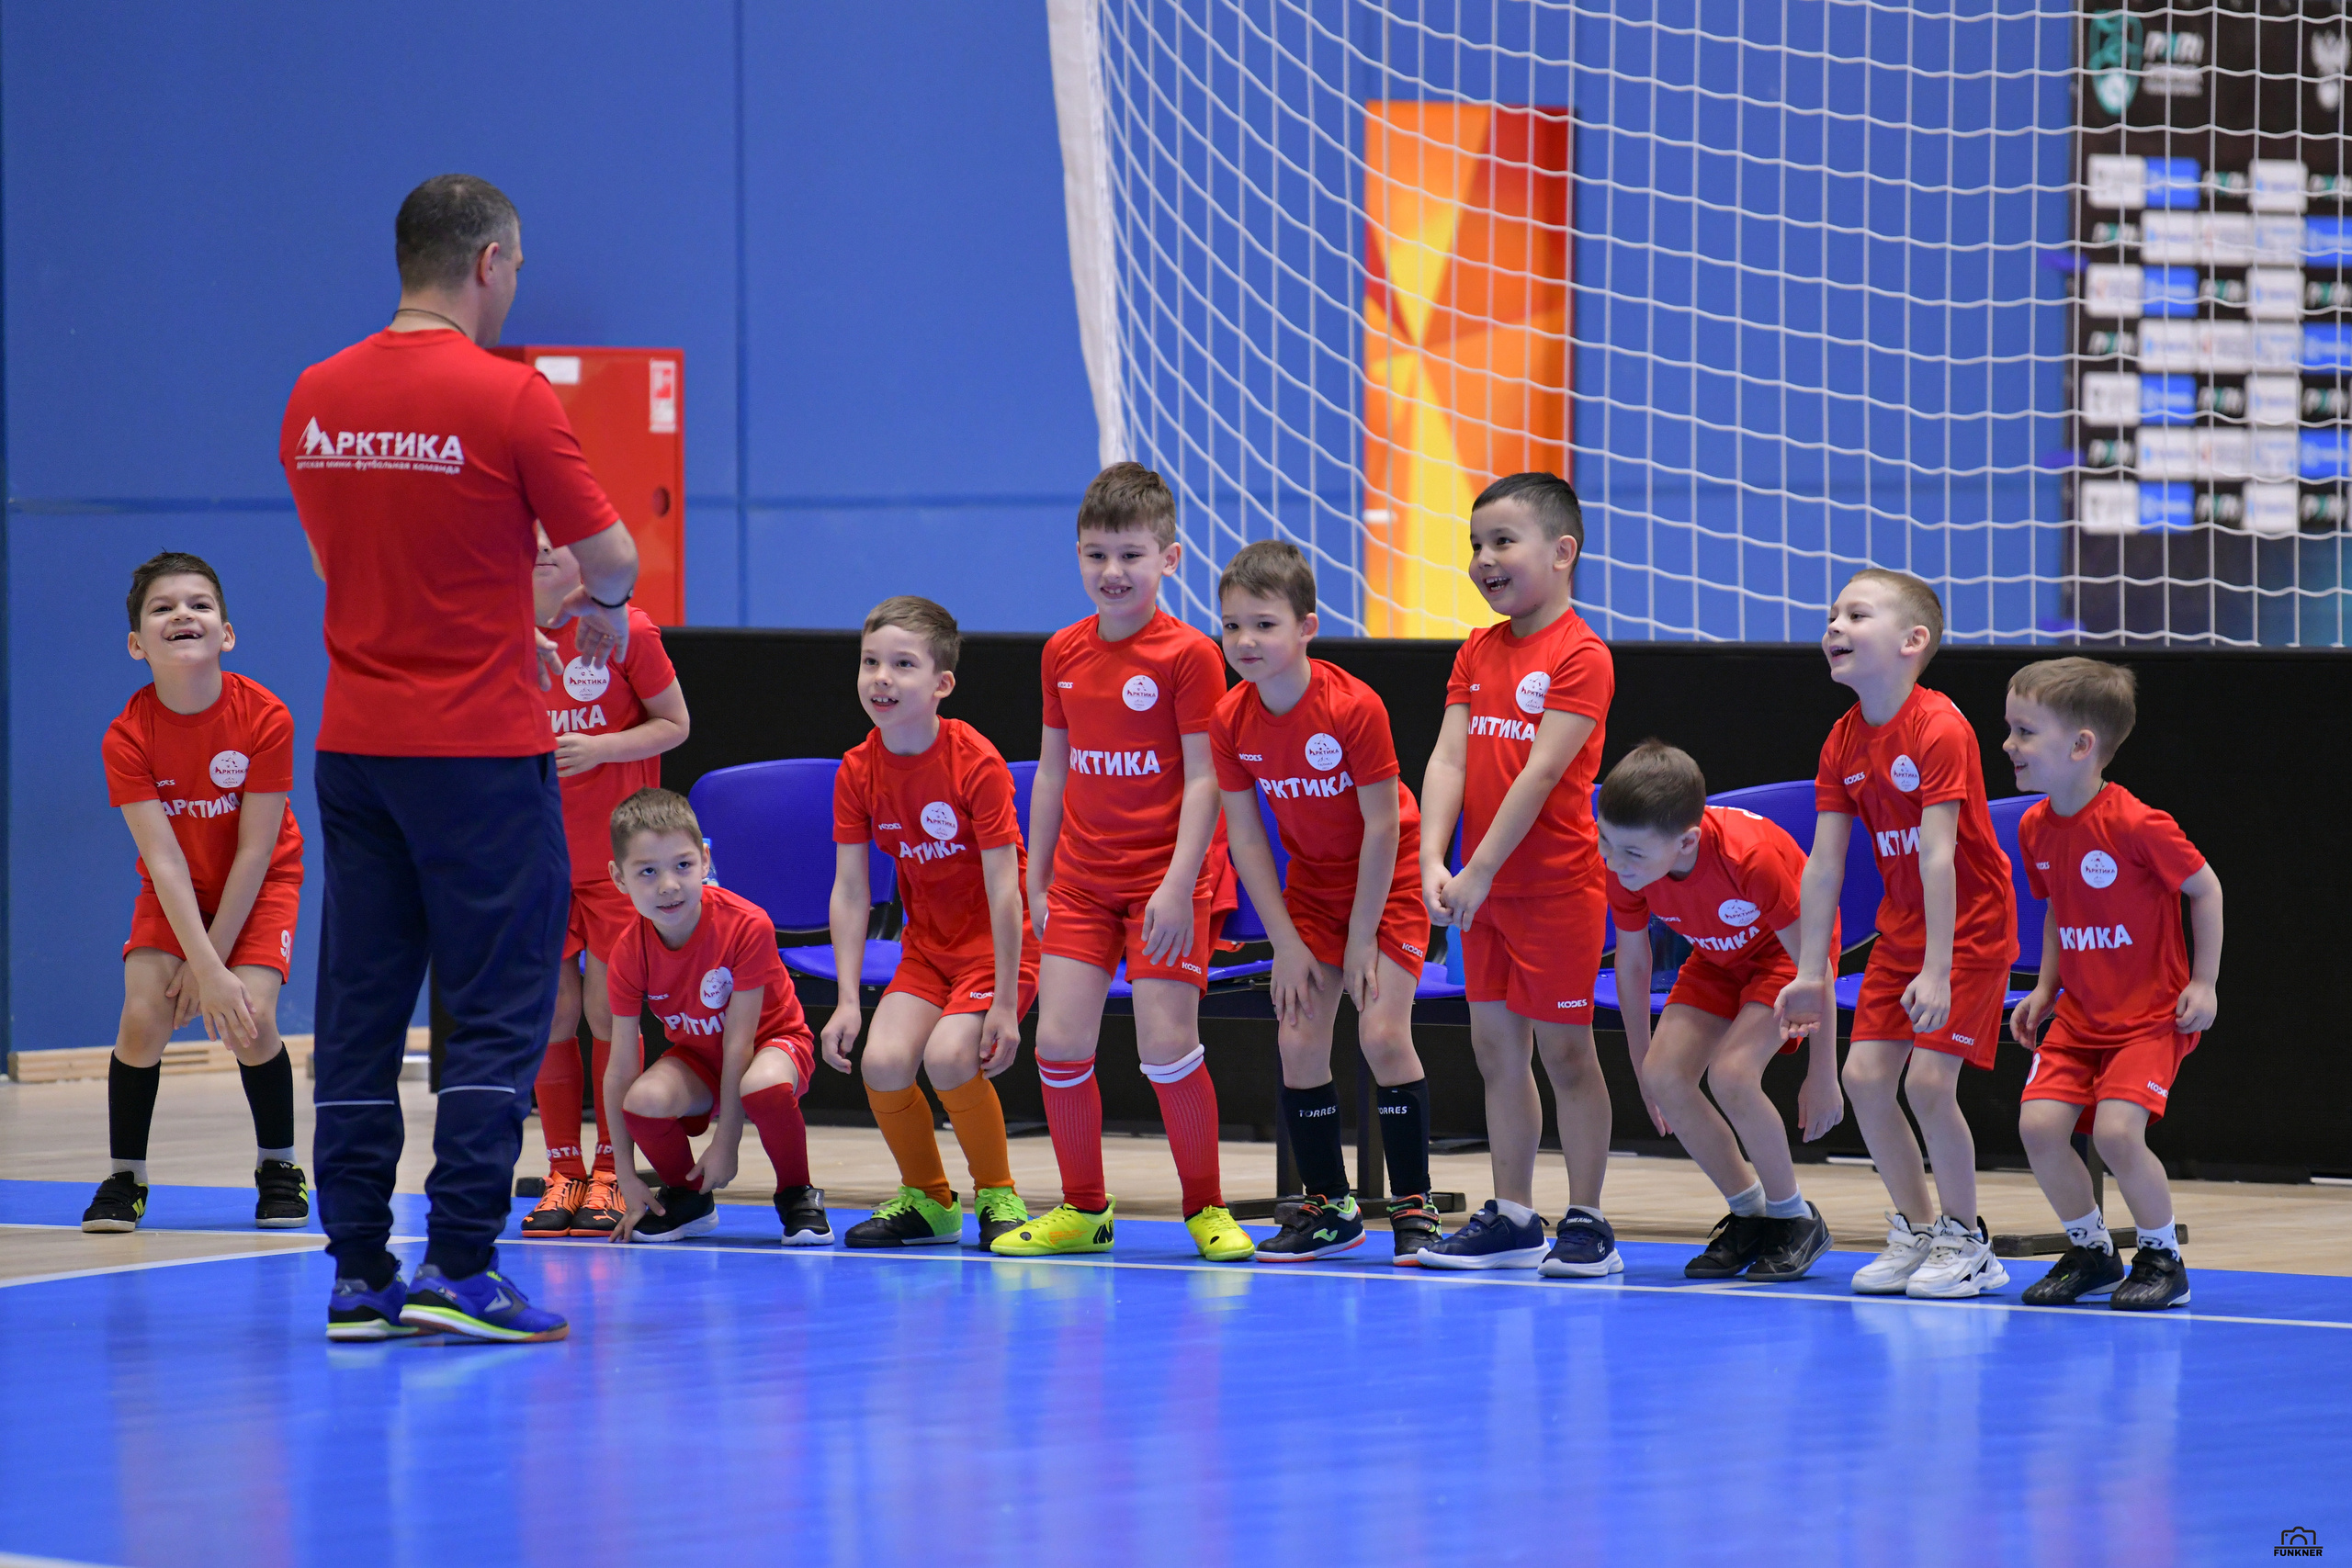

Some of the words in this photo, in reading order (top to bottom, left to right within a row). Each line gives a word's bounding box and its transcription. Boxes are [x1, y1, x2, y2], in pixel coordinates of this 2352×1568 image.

[295, 416, 465, 462] АРКТИКА
[413, 464, 460, 474] команда
[570, 676, 606, 685] АРКТИКА
[1127, 690, 1156, 698] АРКТИКА
[547, 704, 607, 733] ИКА
[1258, 771, 1354, 799] РКТИКА
[2085, 865, 2115, 874] АРКТИКА
[1557, 998, 1588, 1009] KODES
[1299, 1105, 1337, 1118] TORRES
